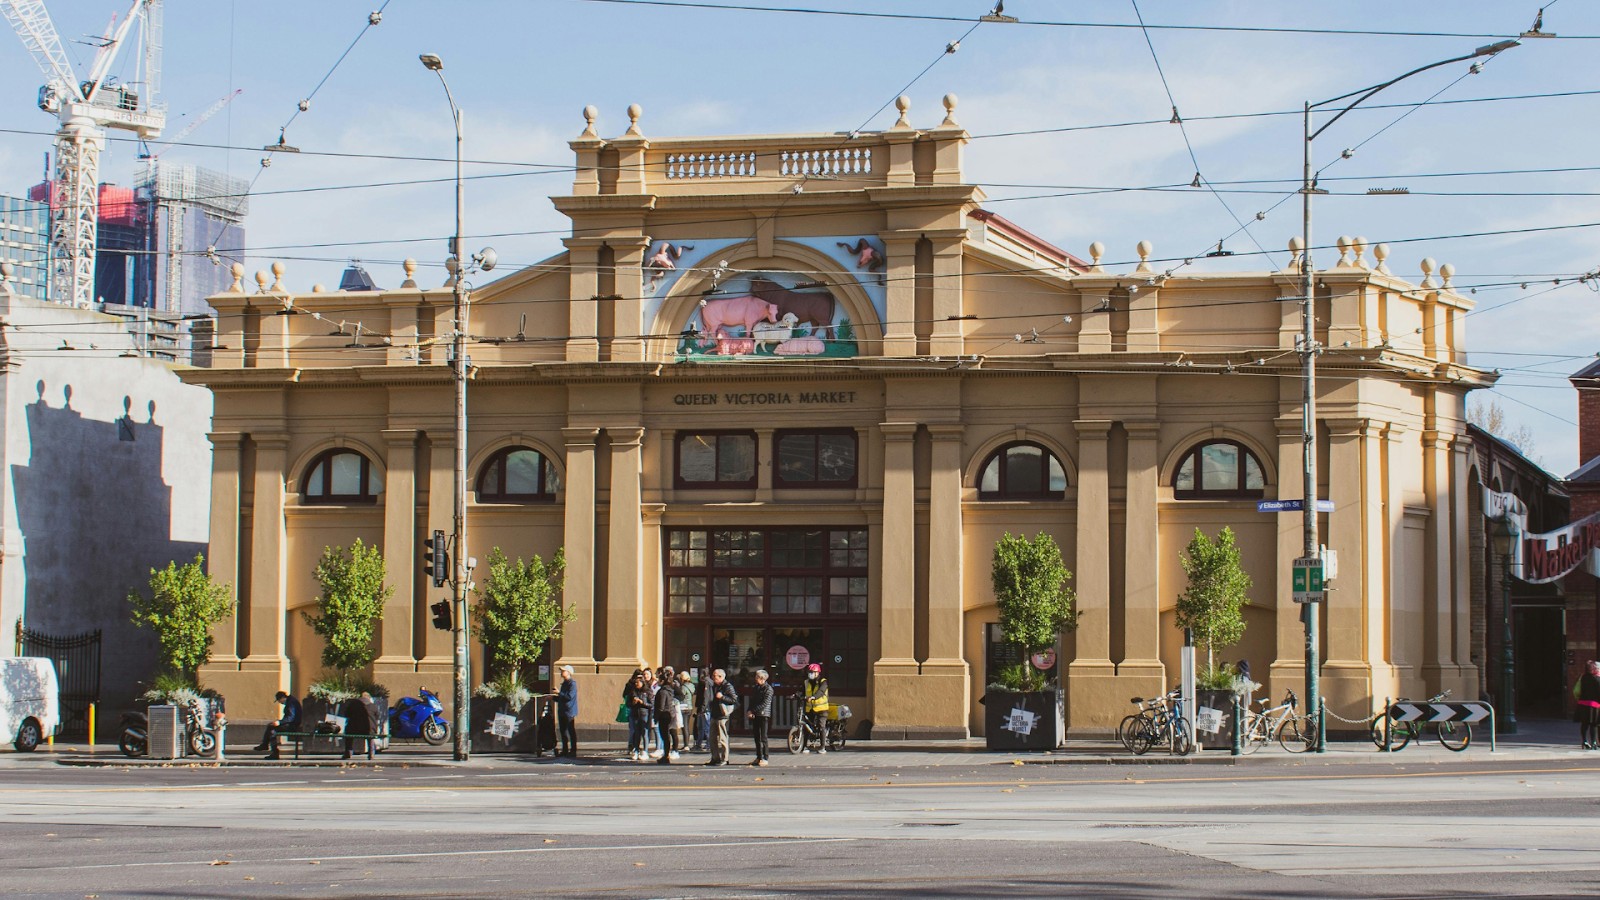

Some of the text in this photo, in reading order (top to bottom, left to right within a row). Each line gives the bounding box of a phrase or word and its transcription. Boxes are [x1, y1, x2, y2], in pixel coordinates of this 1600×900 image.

[674, 391, 856, 405] QUEEN VICTORIA MARKET
[1263, 501, 1291, 509] Elizabeth
[1524, 529, 1586, 580] Market
[1294, 559, 1322, 567] FAIRWAY
